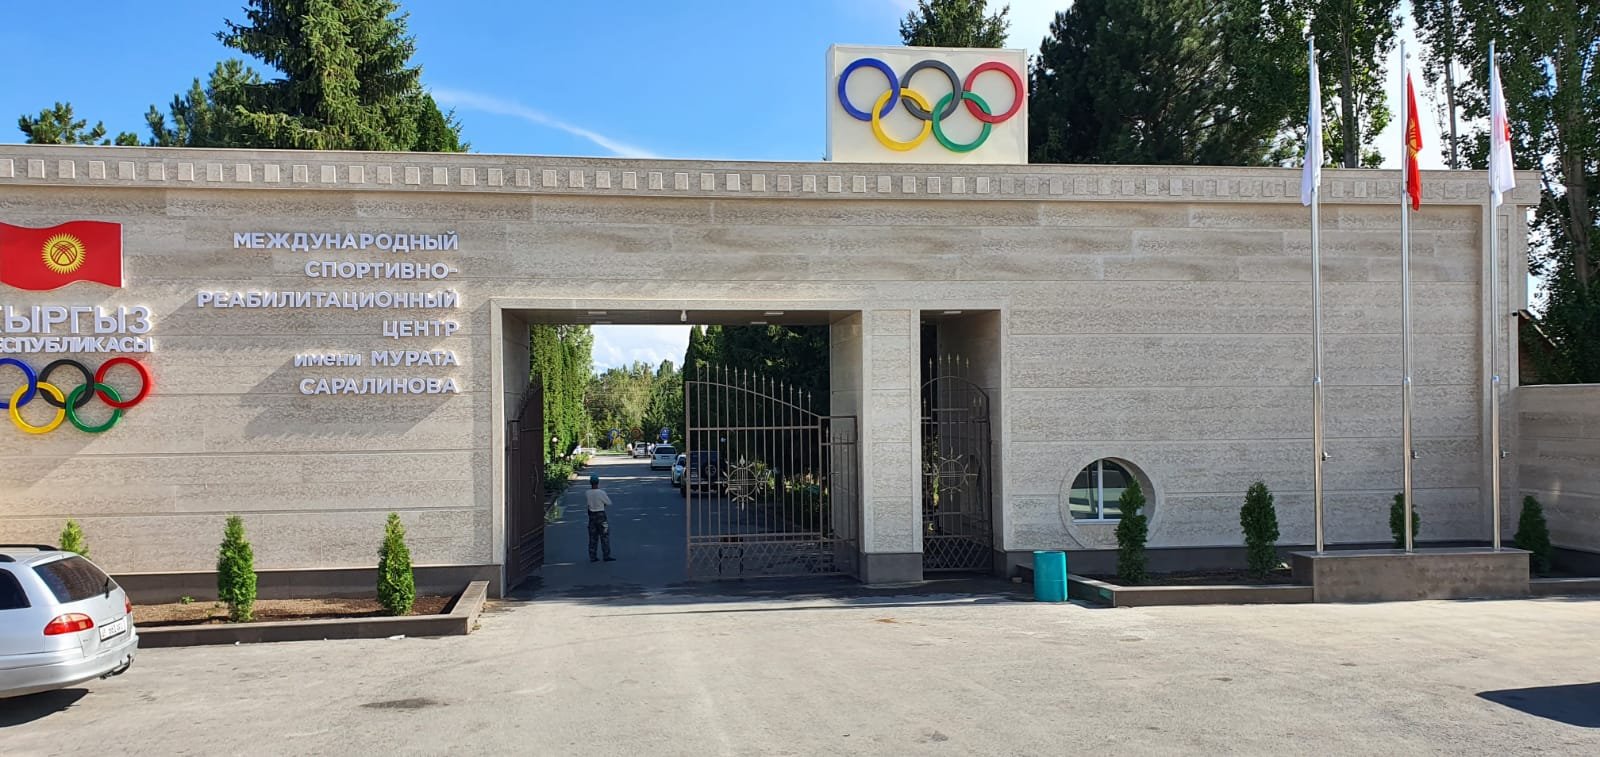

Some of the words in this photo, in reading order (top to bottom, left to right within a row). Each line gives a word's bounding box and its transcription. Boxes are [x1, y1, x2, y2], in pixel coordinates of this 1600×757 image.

[233, 230, 459, 253] МЕЖДУНАРОДНЫЙ
[304, 260, 459, 280] СПОРТИВНО-
[197, 288, 460, 311] РЕАБИЛИТАЦИОННЫЙ
[0, 305, 152, 334] ЫРГЫЗ
[382, 320, 460, 340] ЦЕНТР
[0, 336, 154, 353] СПУБЛИКАСЫ
[294, 353, 362, 368] имени
[371, 350, 460, 367] МУРАТА
[299, 377, 460, 395] САРАЛИНОВА
